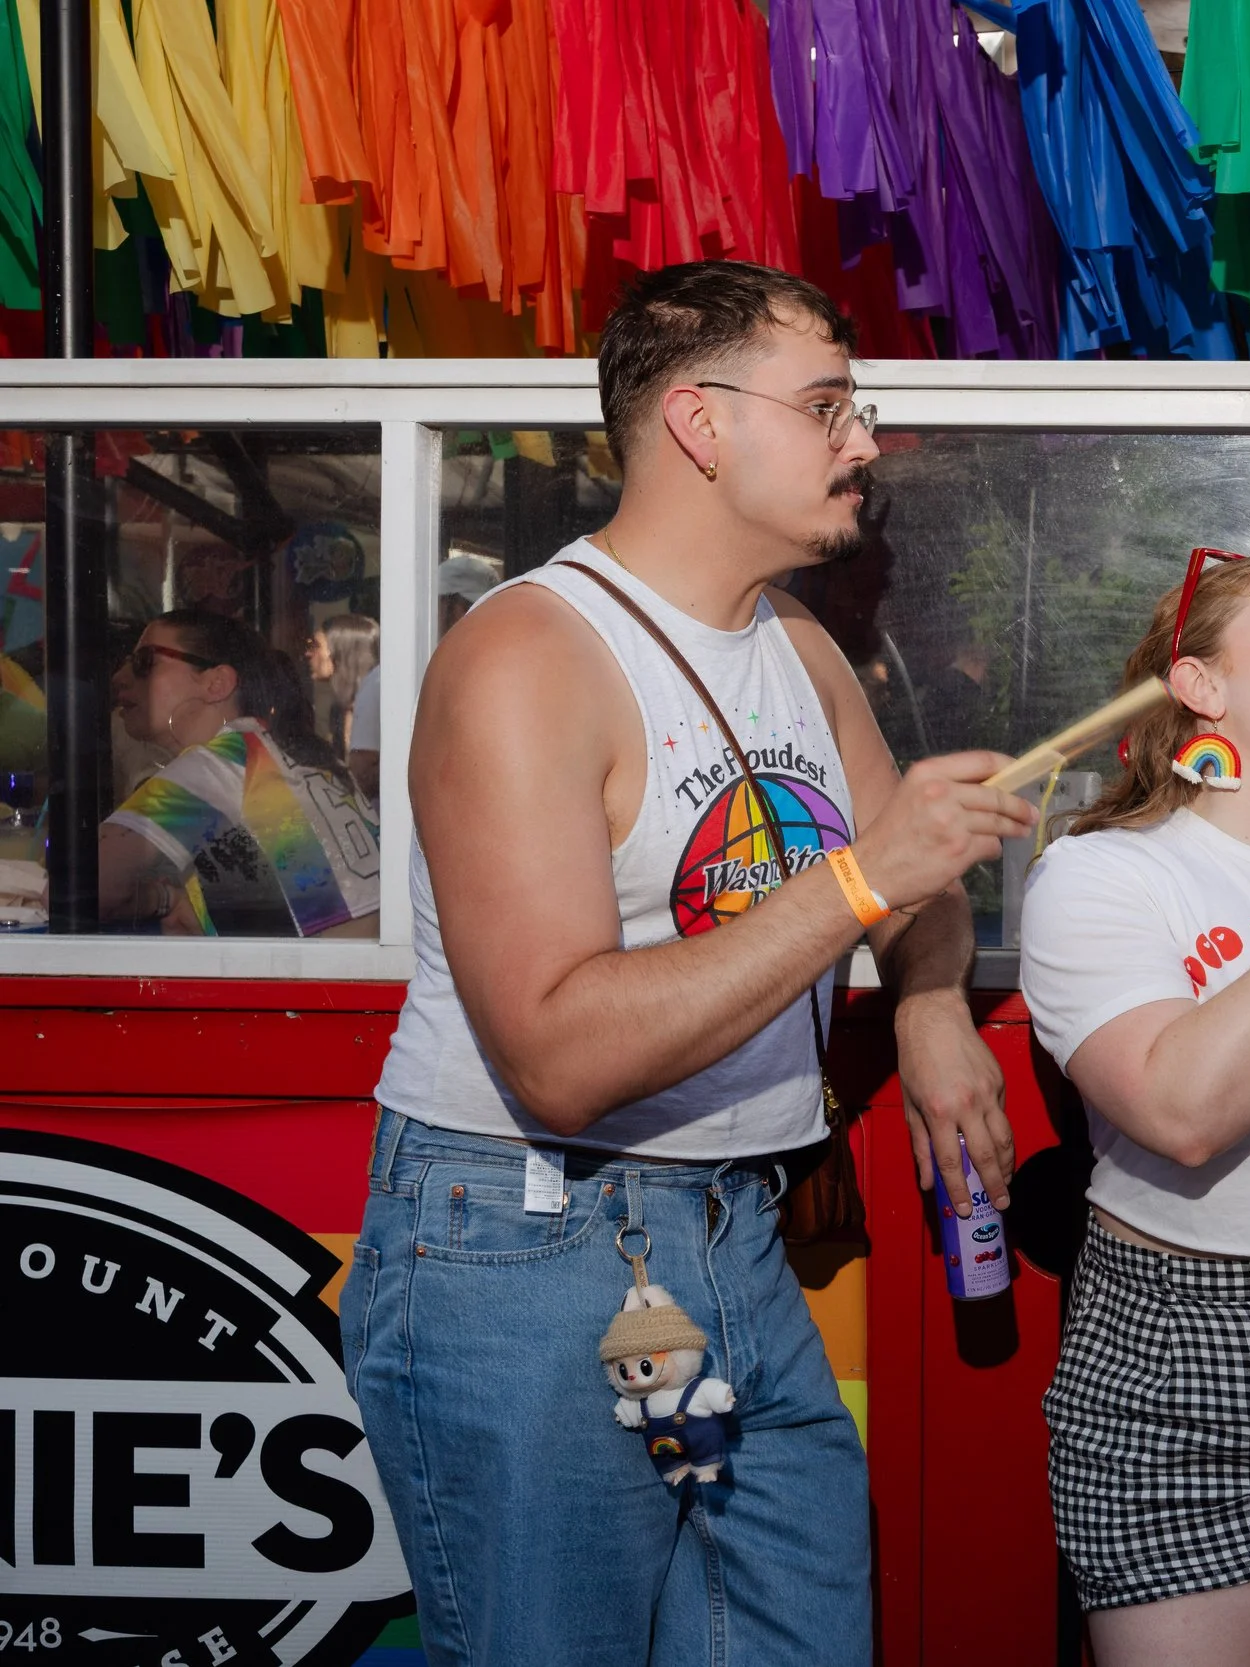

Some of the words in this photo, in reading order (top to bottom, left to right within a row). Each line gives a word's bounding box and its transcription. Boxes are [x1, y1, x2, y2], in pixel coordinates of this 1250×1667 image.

[675, 767, 726, 811] The
[723, 742, 826, 788] Poudest
[0, 1408, 375, 1573] IE'S
